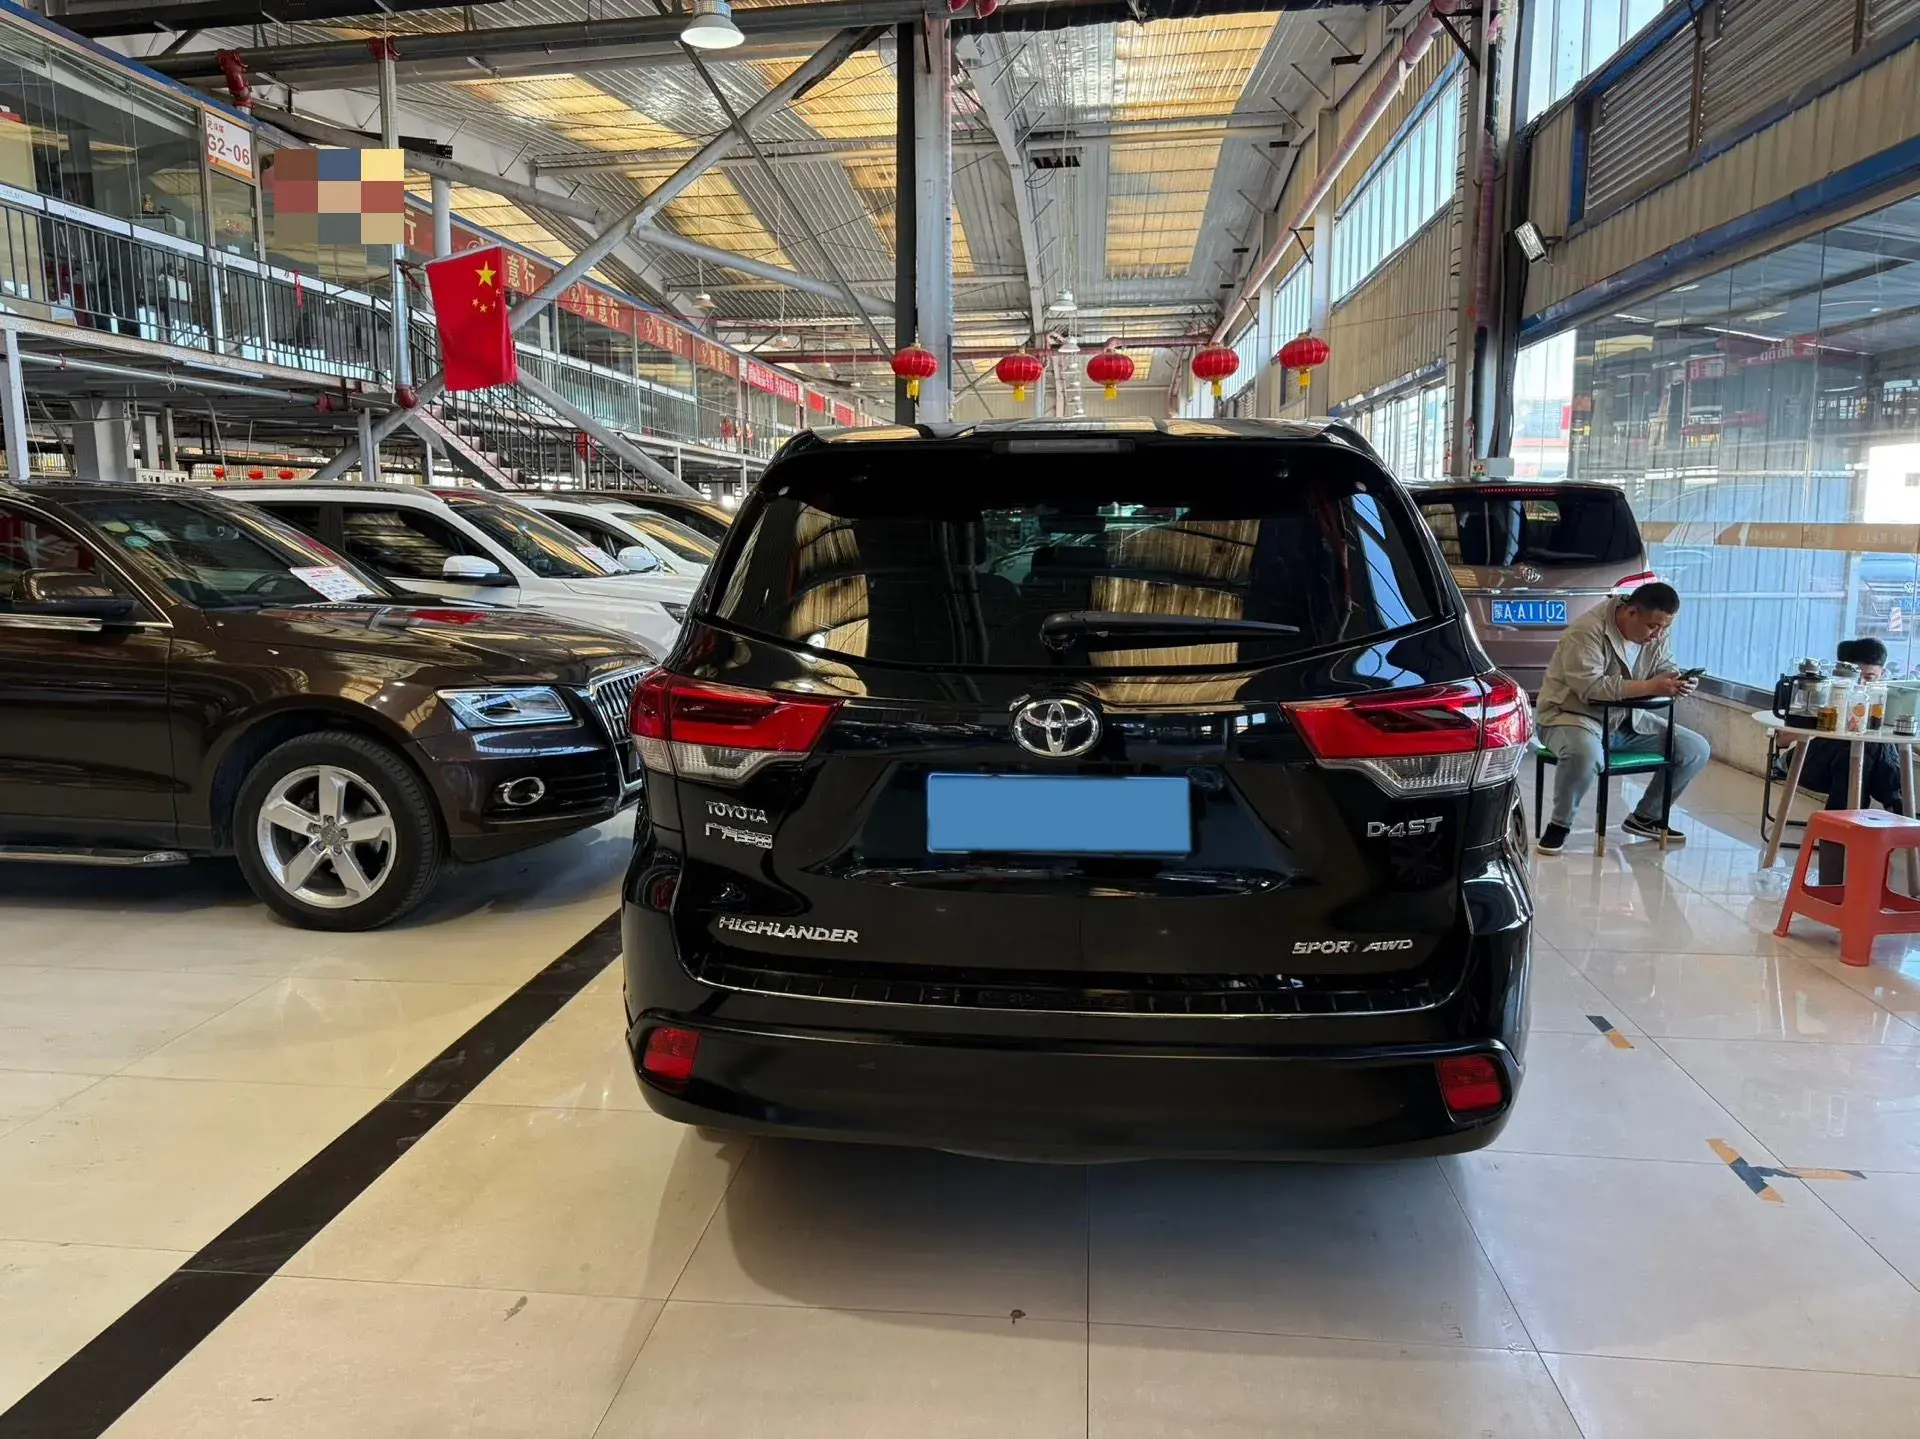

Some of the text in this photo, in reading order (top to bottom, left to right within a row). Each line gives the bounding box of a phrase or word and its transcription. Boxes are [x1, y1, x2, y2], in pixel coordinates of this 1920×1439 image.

[705, 800, 769, 824] TOYOTA
[718, 916, 859, 944] HIGHLANDER
[1362, 939, 1413, 952] AWD
